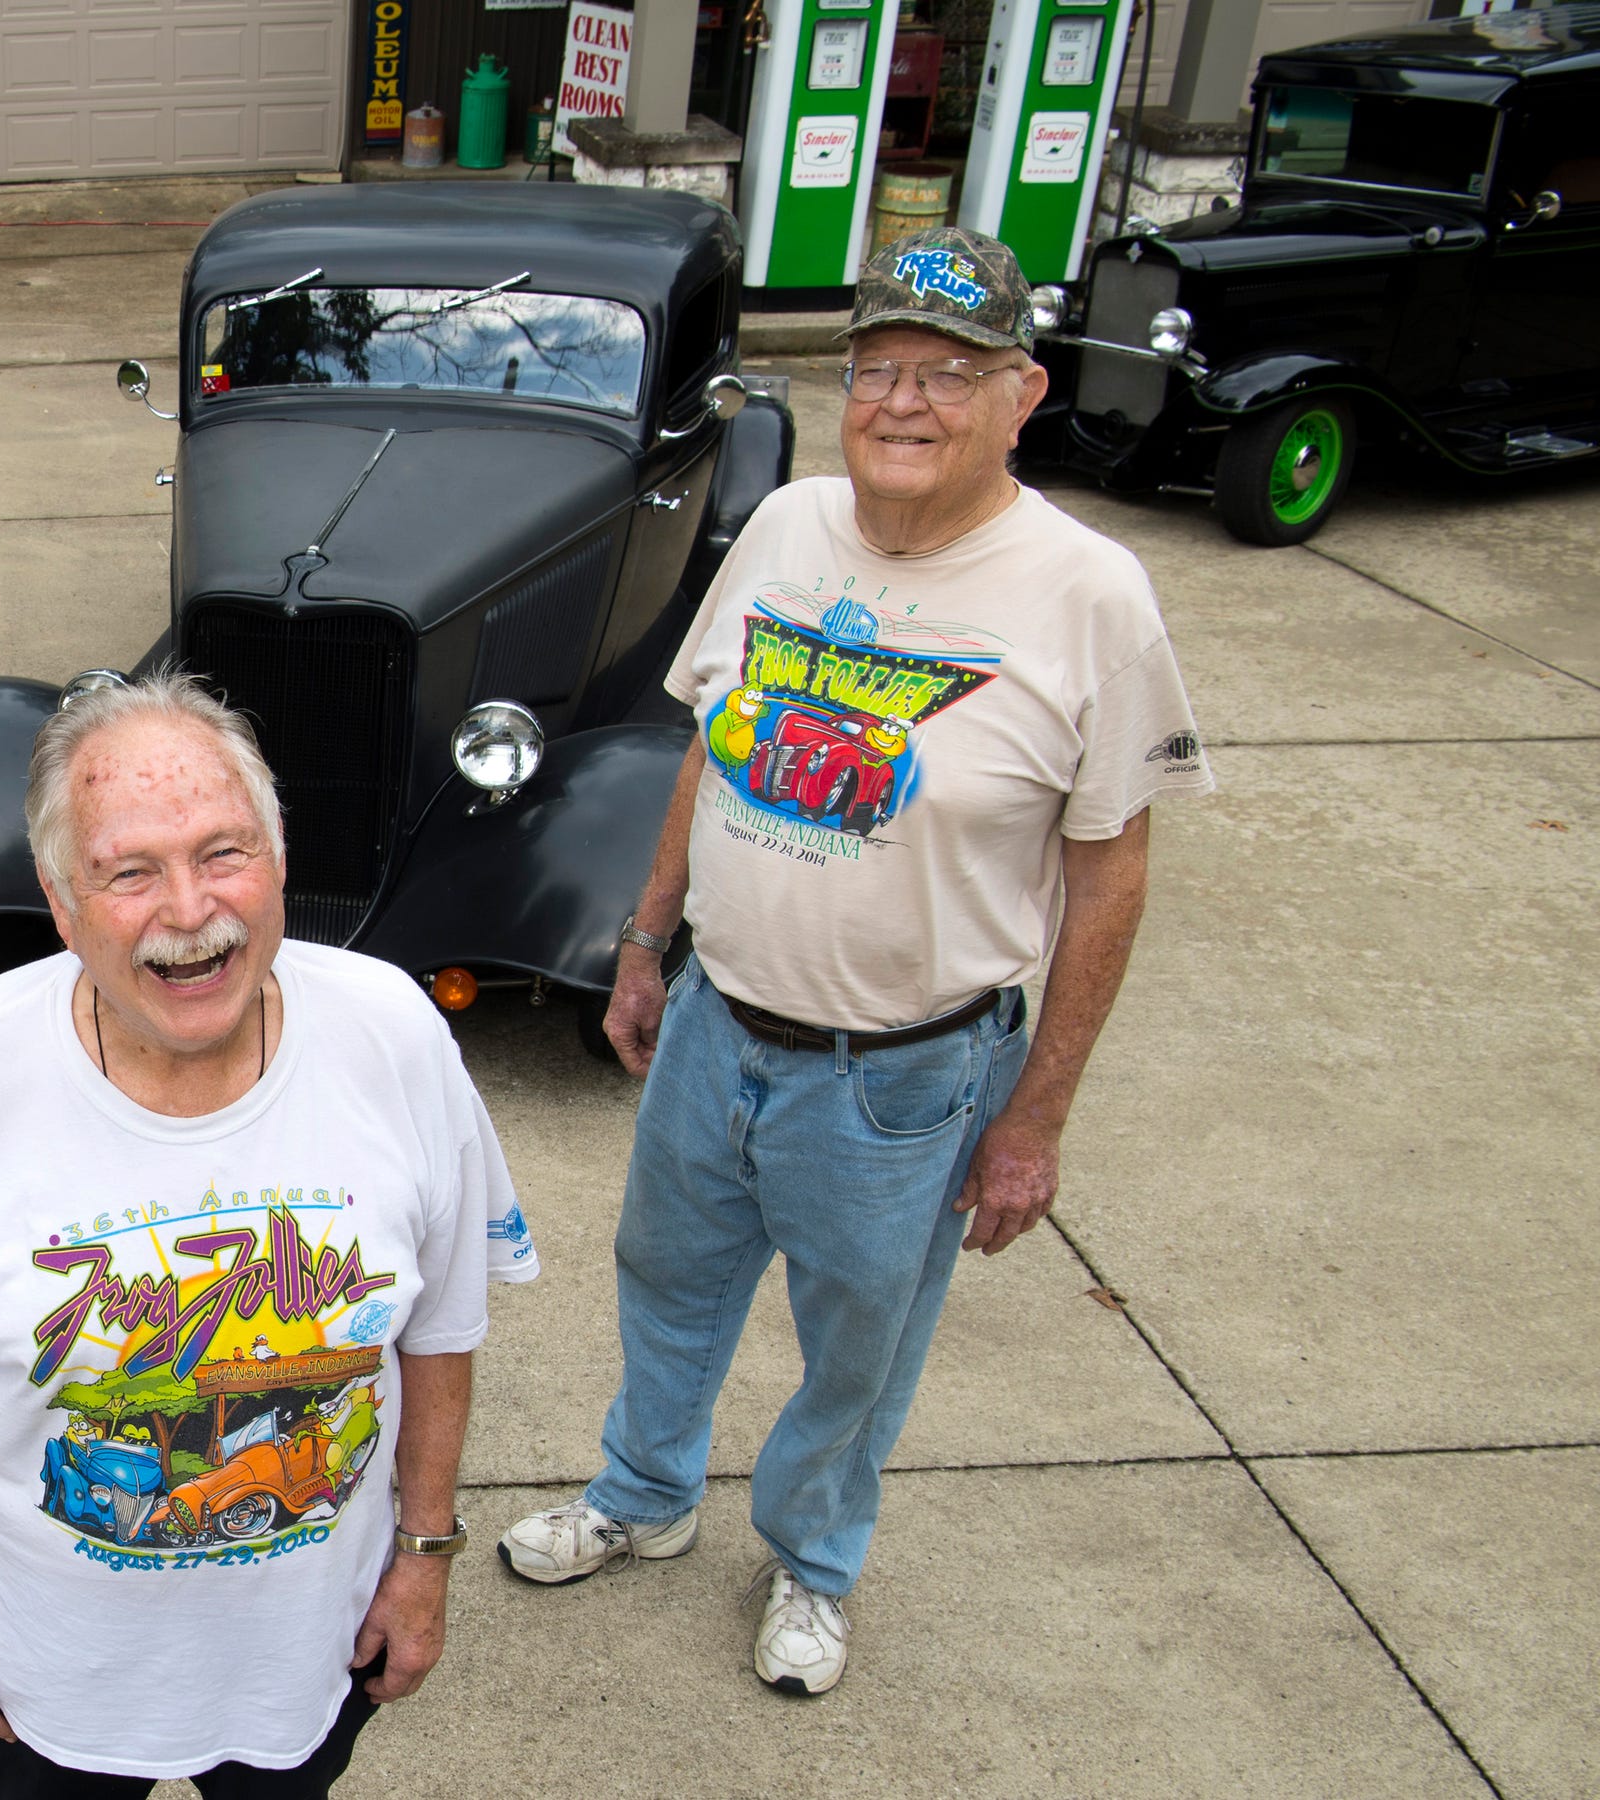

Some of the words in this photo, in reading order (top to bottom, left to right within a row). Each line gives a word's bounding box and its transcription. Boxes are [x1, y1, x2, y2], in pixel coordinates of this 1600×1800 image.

[573, 15, 632, 52] CLEAN
[574, 51, 622, 86] REST
[369, 107, 399, 115] MOTOR
[560, 83, 624, 118] ROOMS
[374, 117, 394, 125] OIL
[1034, 127, 1079, 141] Sinclair
[803, 132, 848, 146] Sinclair
[843, 621, 879, 643] ANNUAL
[748, 630, 811, 689] FROG
[811, 652, 954, 720] FOLLIES
[1164, 763, 1200, 773] OFFICIAL
[715, 789, 786, 839] EVANSVILLE,
[787, 822, 864, 860] INDIANA
[722, 818, 758, 844] August
[795, 849, 826, 867] 2014
[62, 1201, 169, 1242] 36th
[199, 1187, 345, 1211] Annual
[28, 1244, 182, 1386] Frog
[173, 1203, 396, 1383] Follies
[206, 1362, 302, 1384] EVANSVILLE,
[307, 1351, 372, 1374] INDIANA
[74, 1537, 166, 1572] August
[172, 1545, 259, 1570] 27-29,
[266, 1525, 331, 1560] 2010
